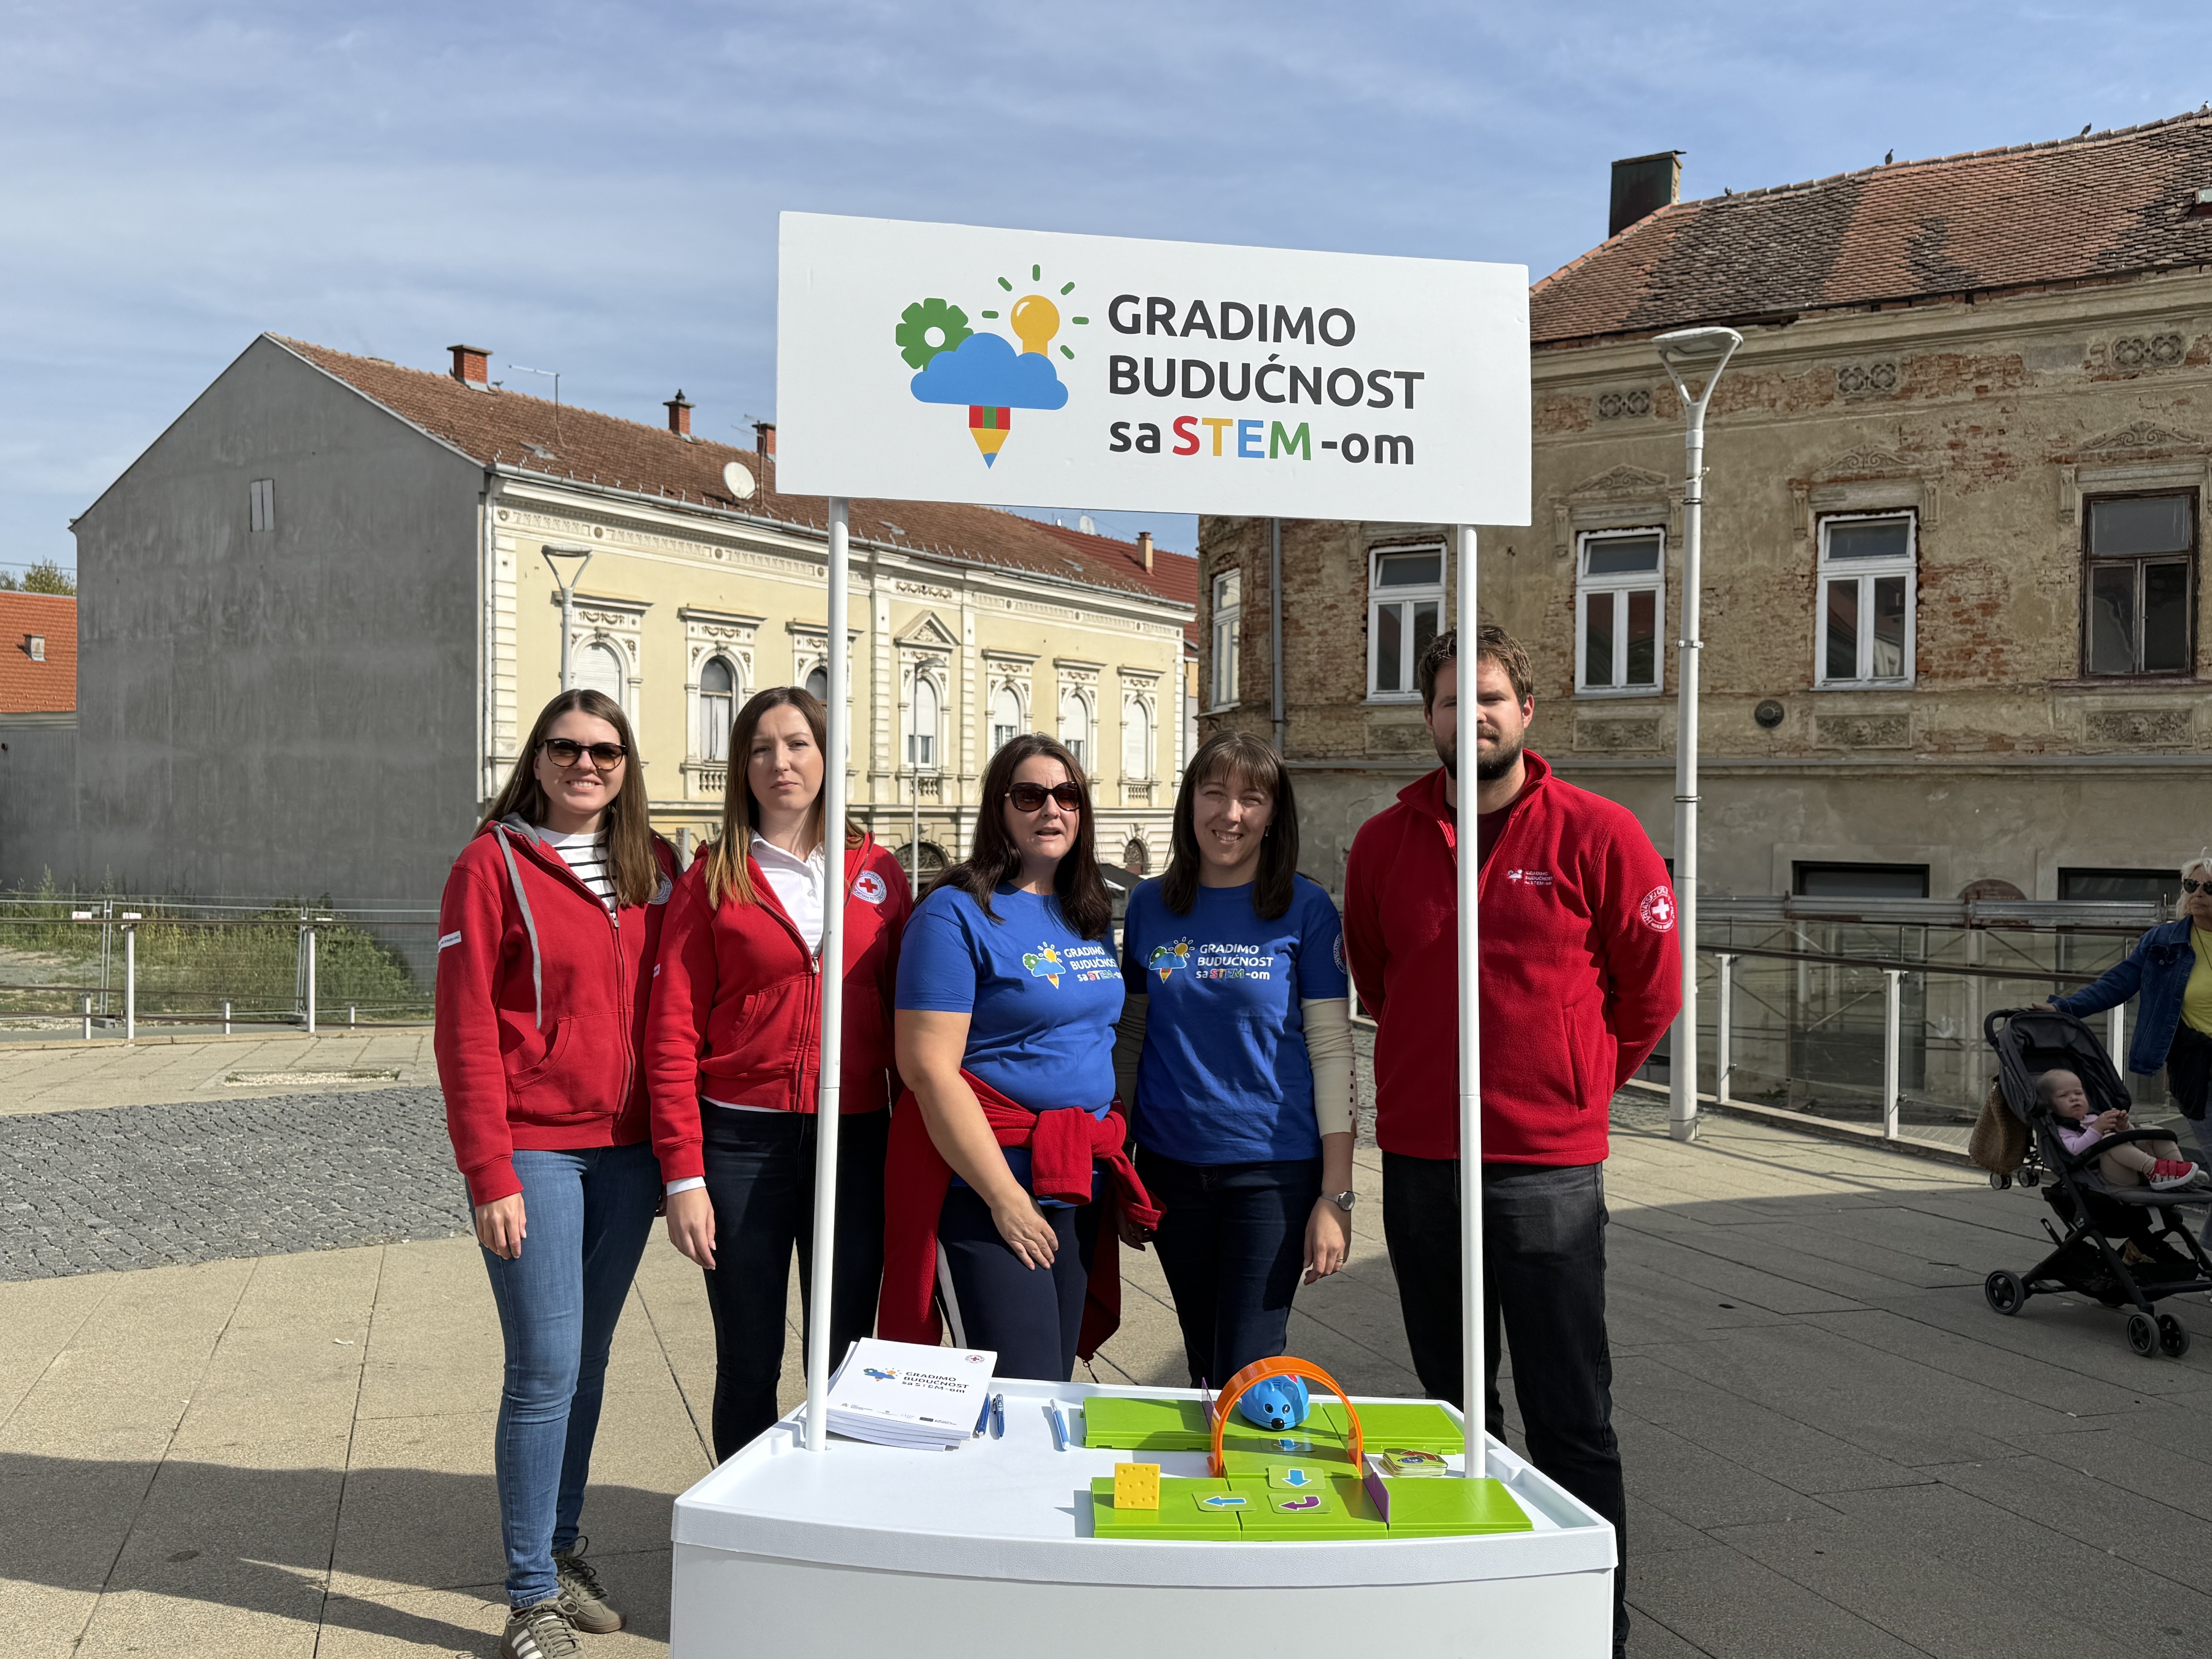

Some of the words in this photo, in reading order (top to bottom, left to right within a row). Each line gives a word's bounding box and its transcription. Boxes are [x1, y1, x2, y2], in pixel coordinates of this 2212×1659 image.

[1108, 294, 1356, 347] GRADIMO
[1109, 353, 1425, 410] BUDUĆNOST
[1064, 946, 1105, 958] GRADIMO
[1199, 943, 1259, 955] GRADIMO
[1069, 957, 1118, 970] BUDUĆNOS
[1197, 954, 1274, 967] BUDUĆNOST
[903, 1376, 969, 1389] BUDUĆNOST
[905, 1372, 957, 1382] GRADIMO
